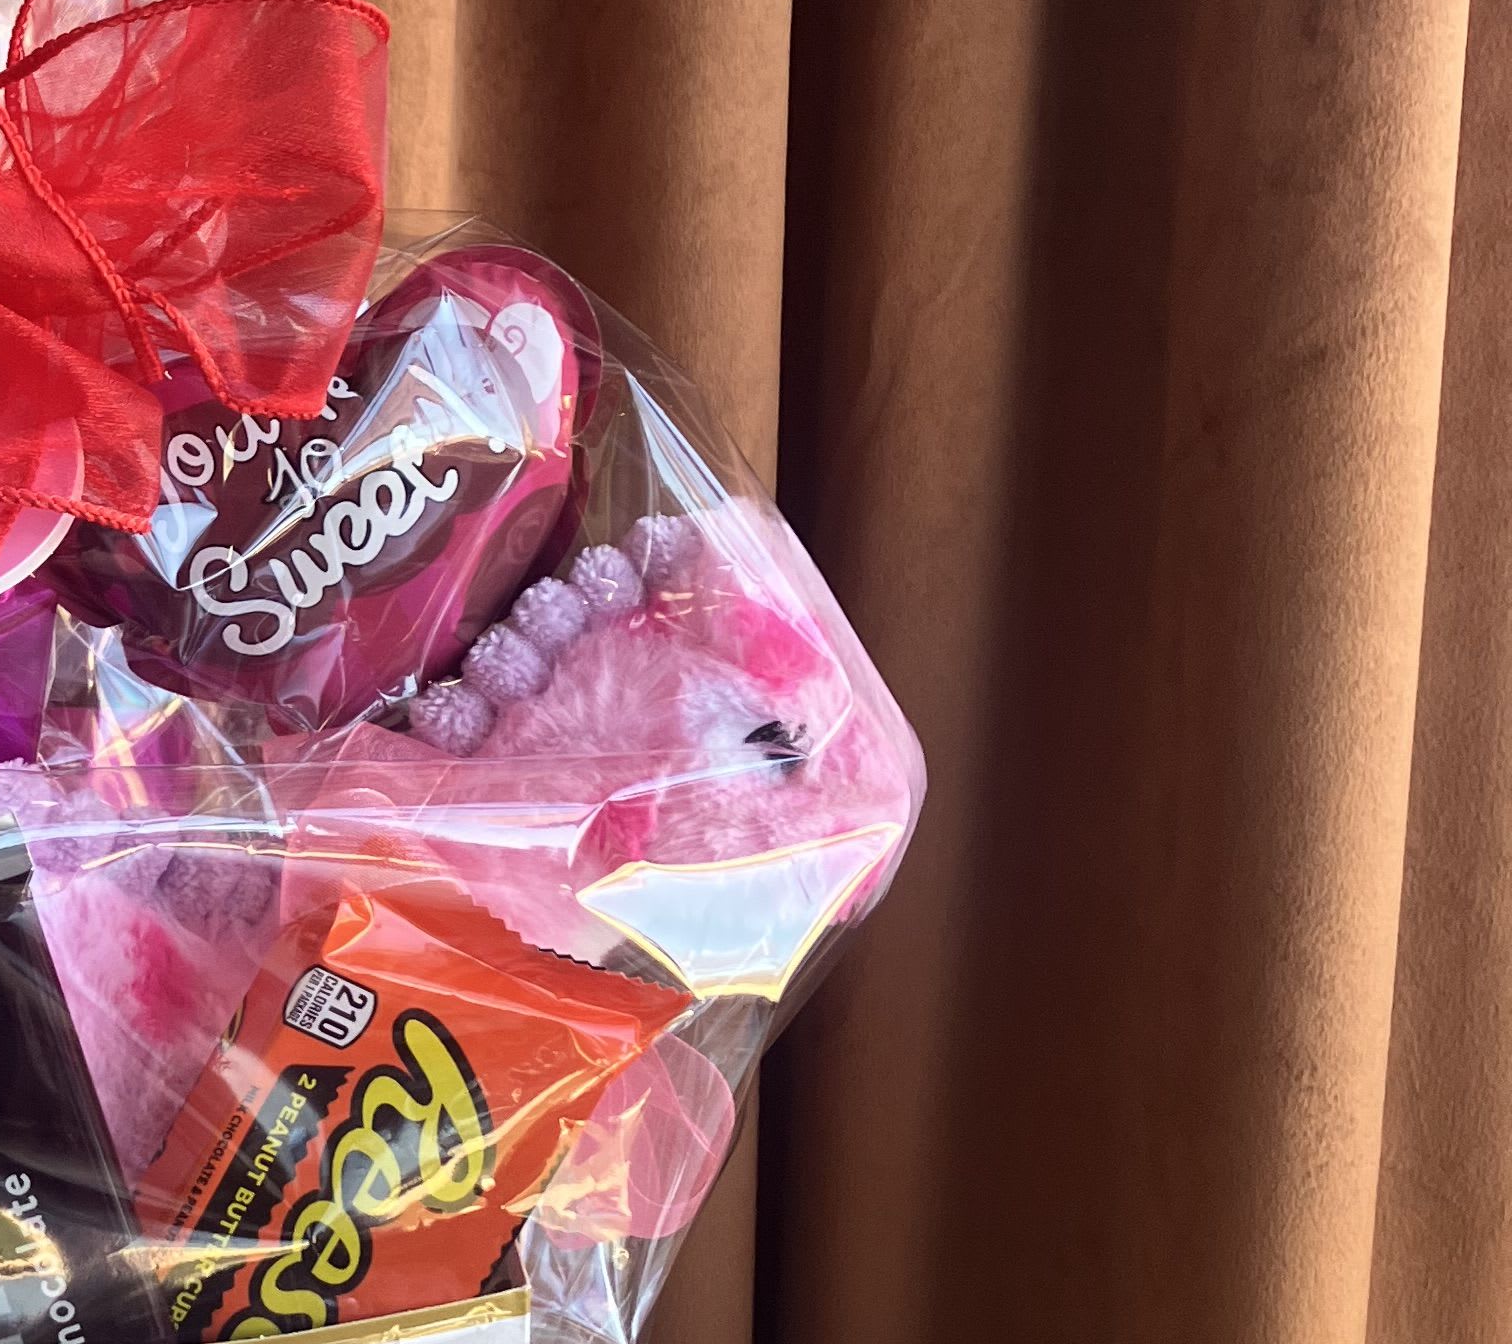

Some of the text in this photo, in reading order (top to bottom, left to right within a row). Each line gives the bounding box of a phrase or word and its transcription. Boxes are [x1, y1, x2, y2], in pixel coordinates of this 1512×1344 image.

[188, 424, 460, 656] Sweet
[299, 976, 338, 1029] CALORIES
[309, 969, 324, 986] PER
[287, 990, 313, 1022] PACKAGE
[318, 984, 368, 1040] 210
[298, 1073, 317, 1090] 2
[195, 1114, 244, 1187] CHOCOLATE
[247, 1091, 307, 1187] PEANUT
